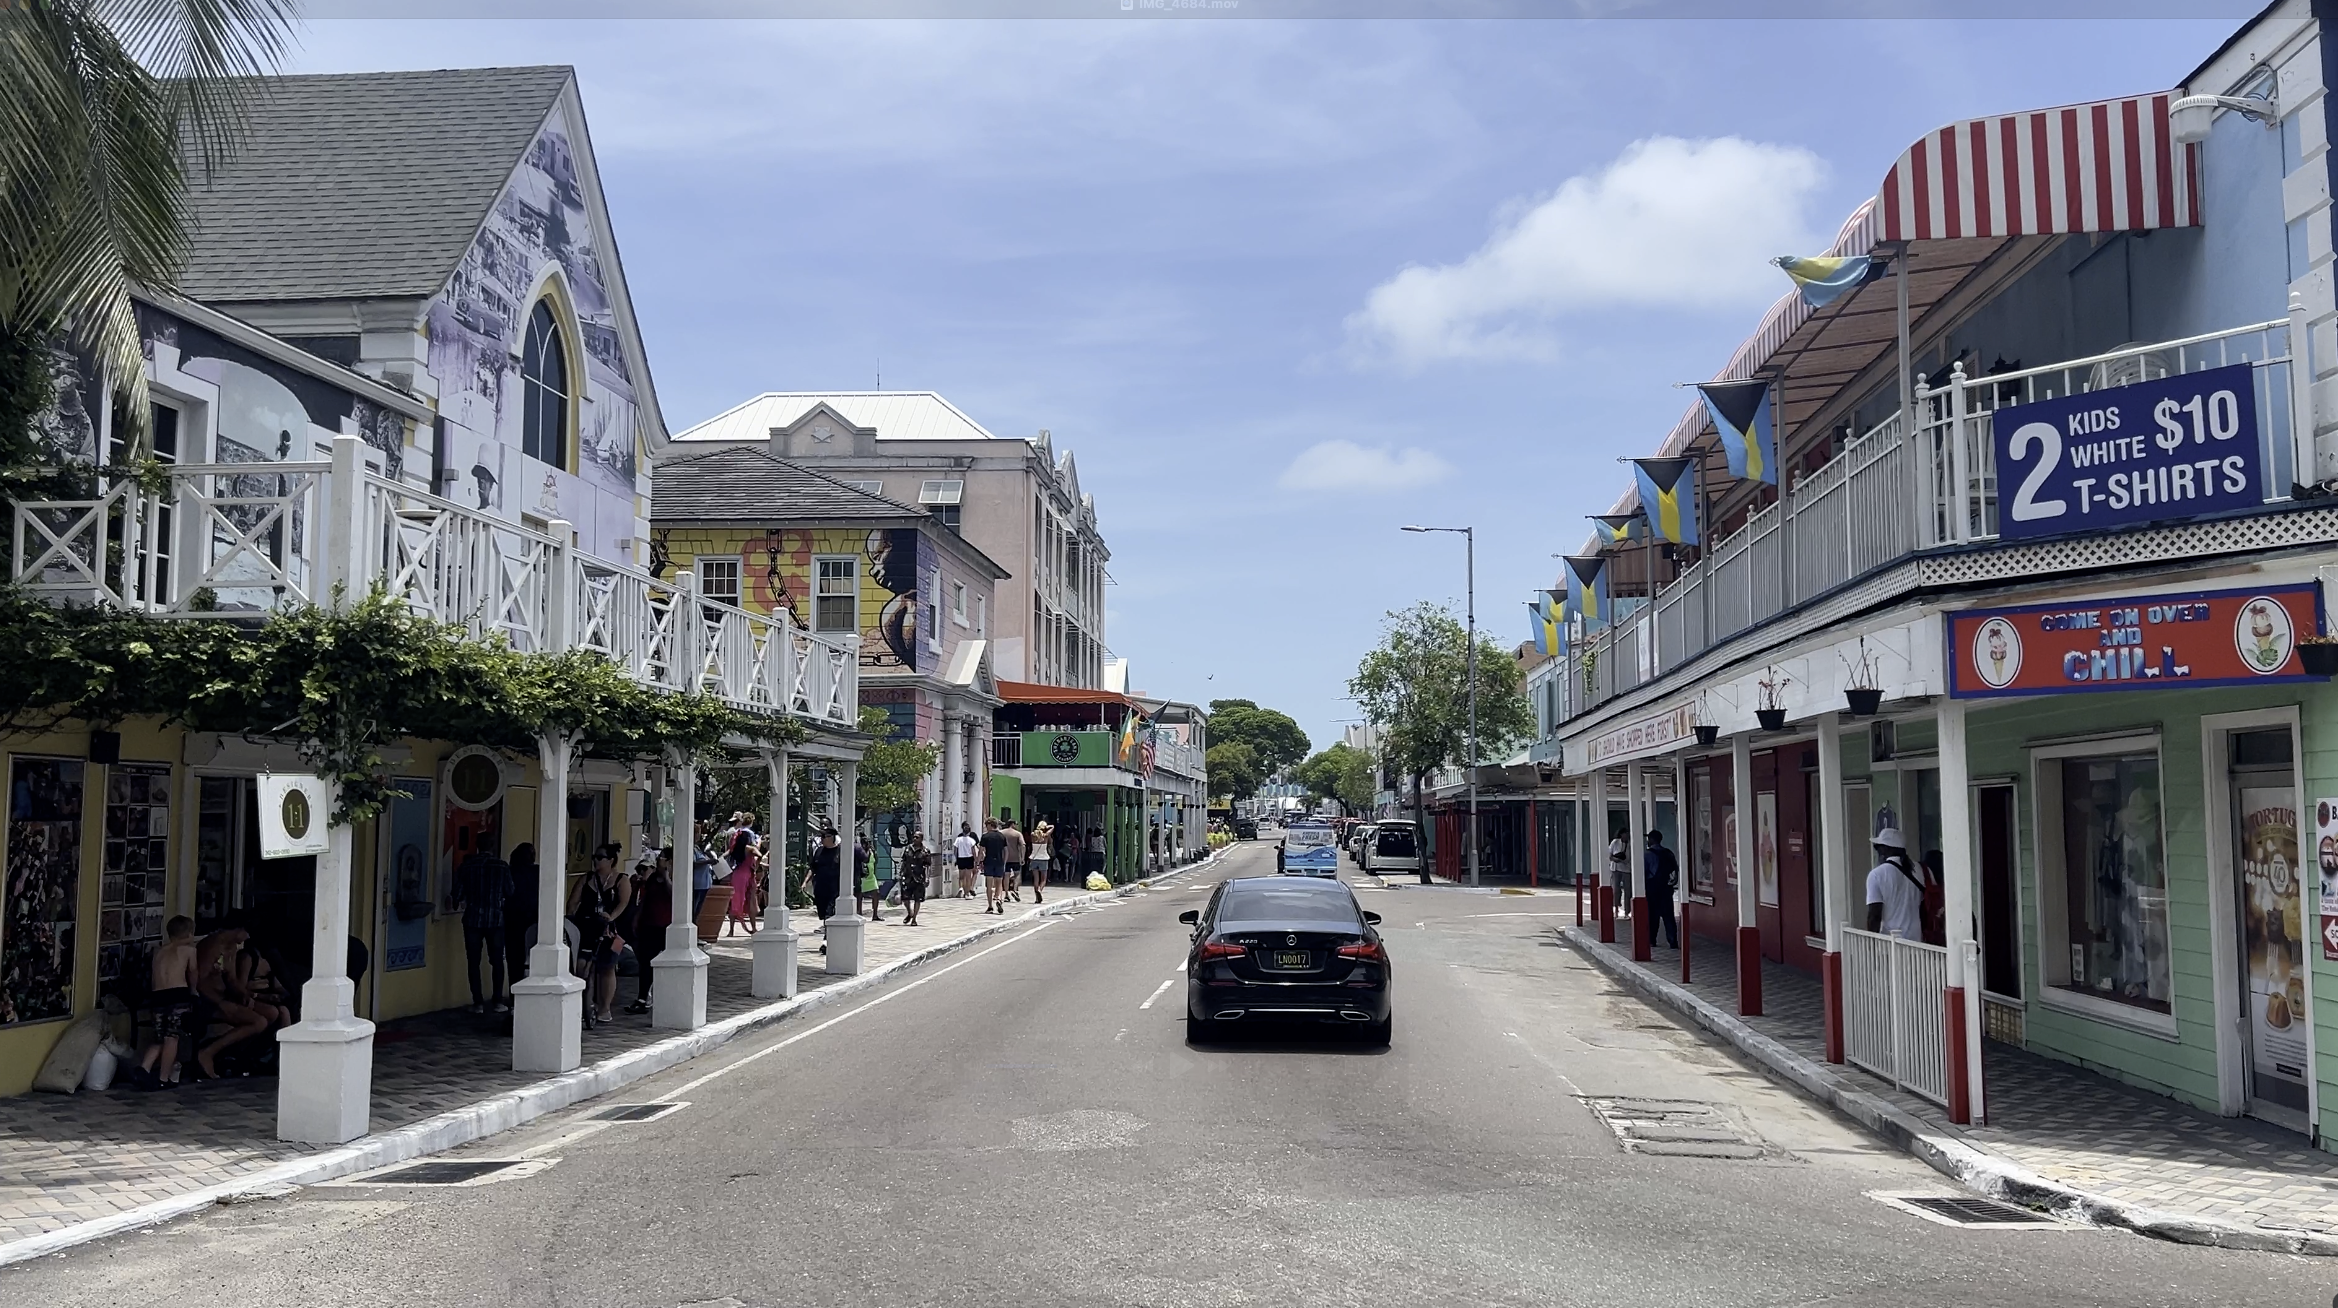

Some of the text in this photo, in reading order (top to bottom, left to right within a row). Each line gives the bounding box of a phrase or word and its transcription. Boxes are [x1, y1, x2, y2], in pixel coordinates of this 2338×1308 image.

[2068, 390, 2240, 455] KIDS $10
[2070, 435, 2147, 469] WHITE
[2009, 422, 2067, 522] 2
[2072, 455, 2247, 514] T-SHIRTS
[2041, 602, 2210, 632] COME ON OVER
[2099, 627, 2143, 647] AND
[2063, 645, 2192, 683] CHILL
[279, 780, 312, 801] DESIGNER
[2331, 805, 2338, 820] B
